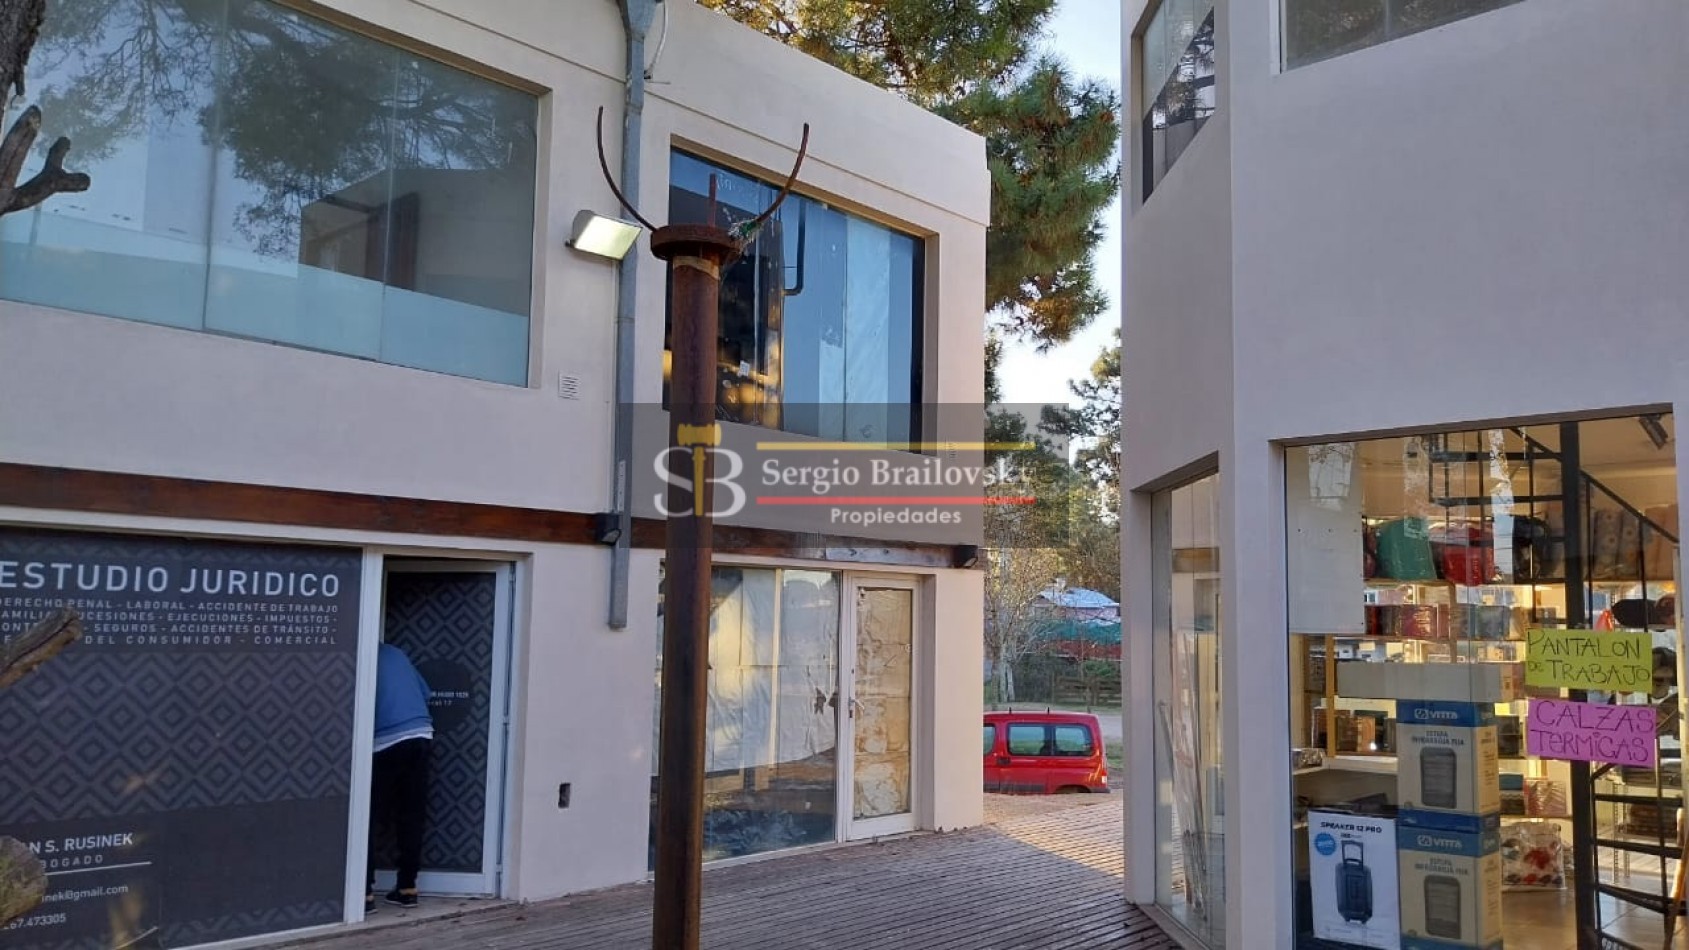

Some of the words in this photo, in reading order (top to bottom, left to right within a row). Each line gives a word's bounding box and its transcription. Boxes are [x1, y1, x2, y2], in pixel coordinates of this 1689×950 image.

[0, 560, 168, 592] ESTUDIO
[180, 568, 339, 597] JURIDICO
[0, 597, 63, 608] ERECHO
[68, 598, 112, 609] PENAL
[127, 600, 184, 610] LABORAL
[198, 602, 267, 612] ACCIDENTE
[270, 603, 285, 612] DE
[288, 603, 338, 613] TRABAJO
[78, 611, 154, 621] UCESIONES
[167, 613, 253, 622] EJECUCIONES
[264, 614, 330, 624] IMPUESTOS
[94, 624, 156, 633] SEGUROS
[171, 624, 249, 633] ACCIDENTES
[254, 625, 268, 634] DE
[85, 635, 115, 645] DEL
[126, 635, 232, 645] CONSUMIDOR
[254, 635, 337, 645] COMERCIAL
[1528, 628, 1640, 658] PANTALON
[1546, 660, 1651, 686] TRABAJO
[1536, 700, 1654, 733] CALZAS
[1365, 825, 1382, 834] PRO
[45, 839, 59, 854] S.
[64, 832, 133, 851] RUSINEK
[40, 854, 103, 869] BOGADO
[41, 884, 129, 902] inek@gmail.com
[3, 912, 67, 930] 67.473305
